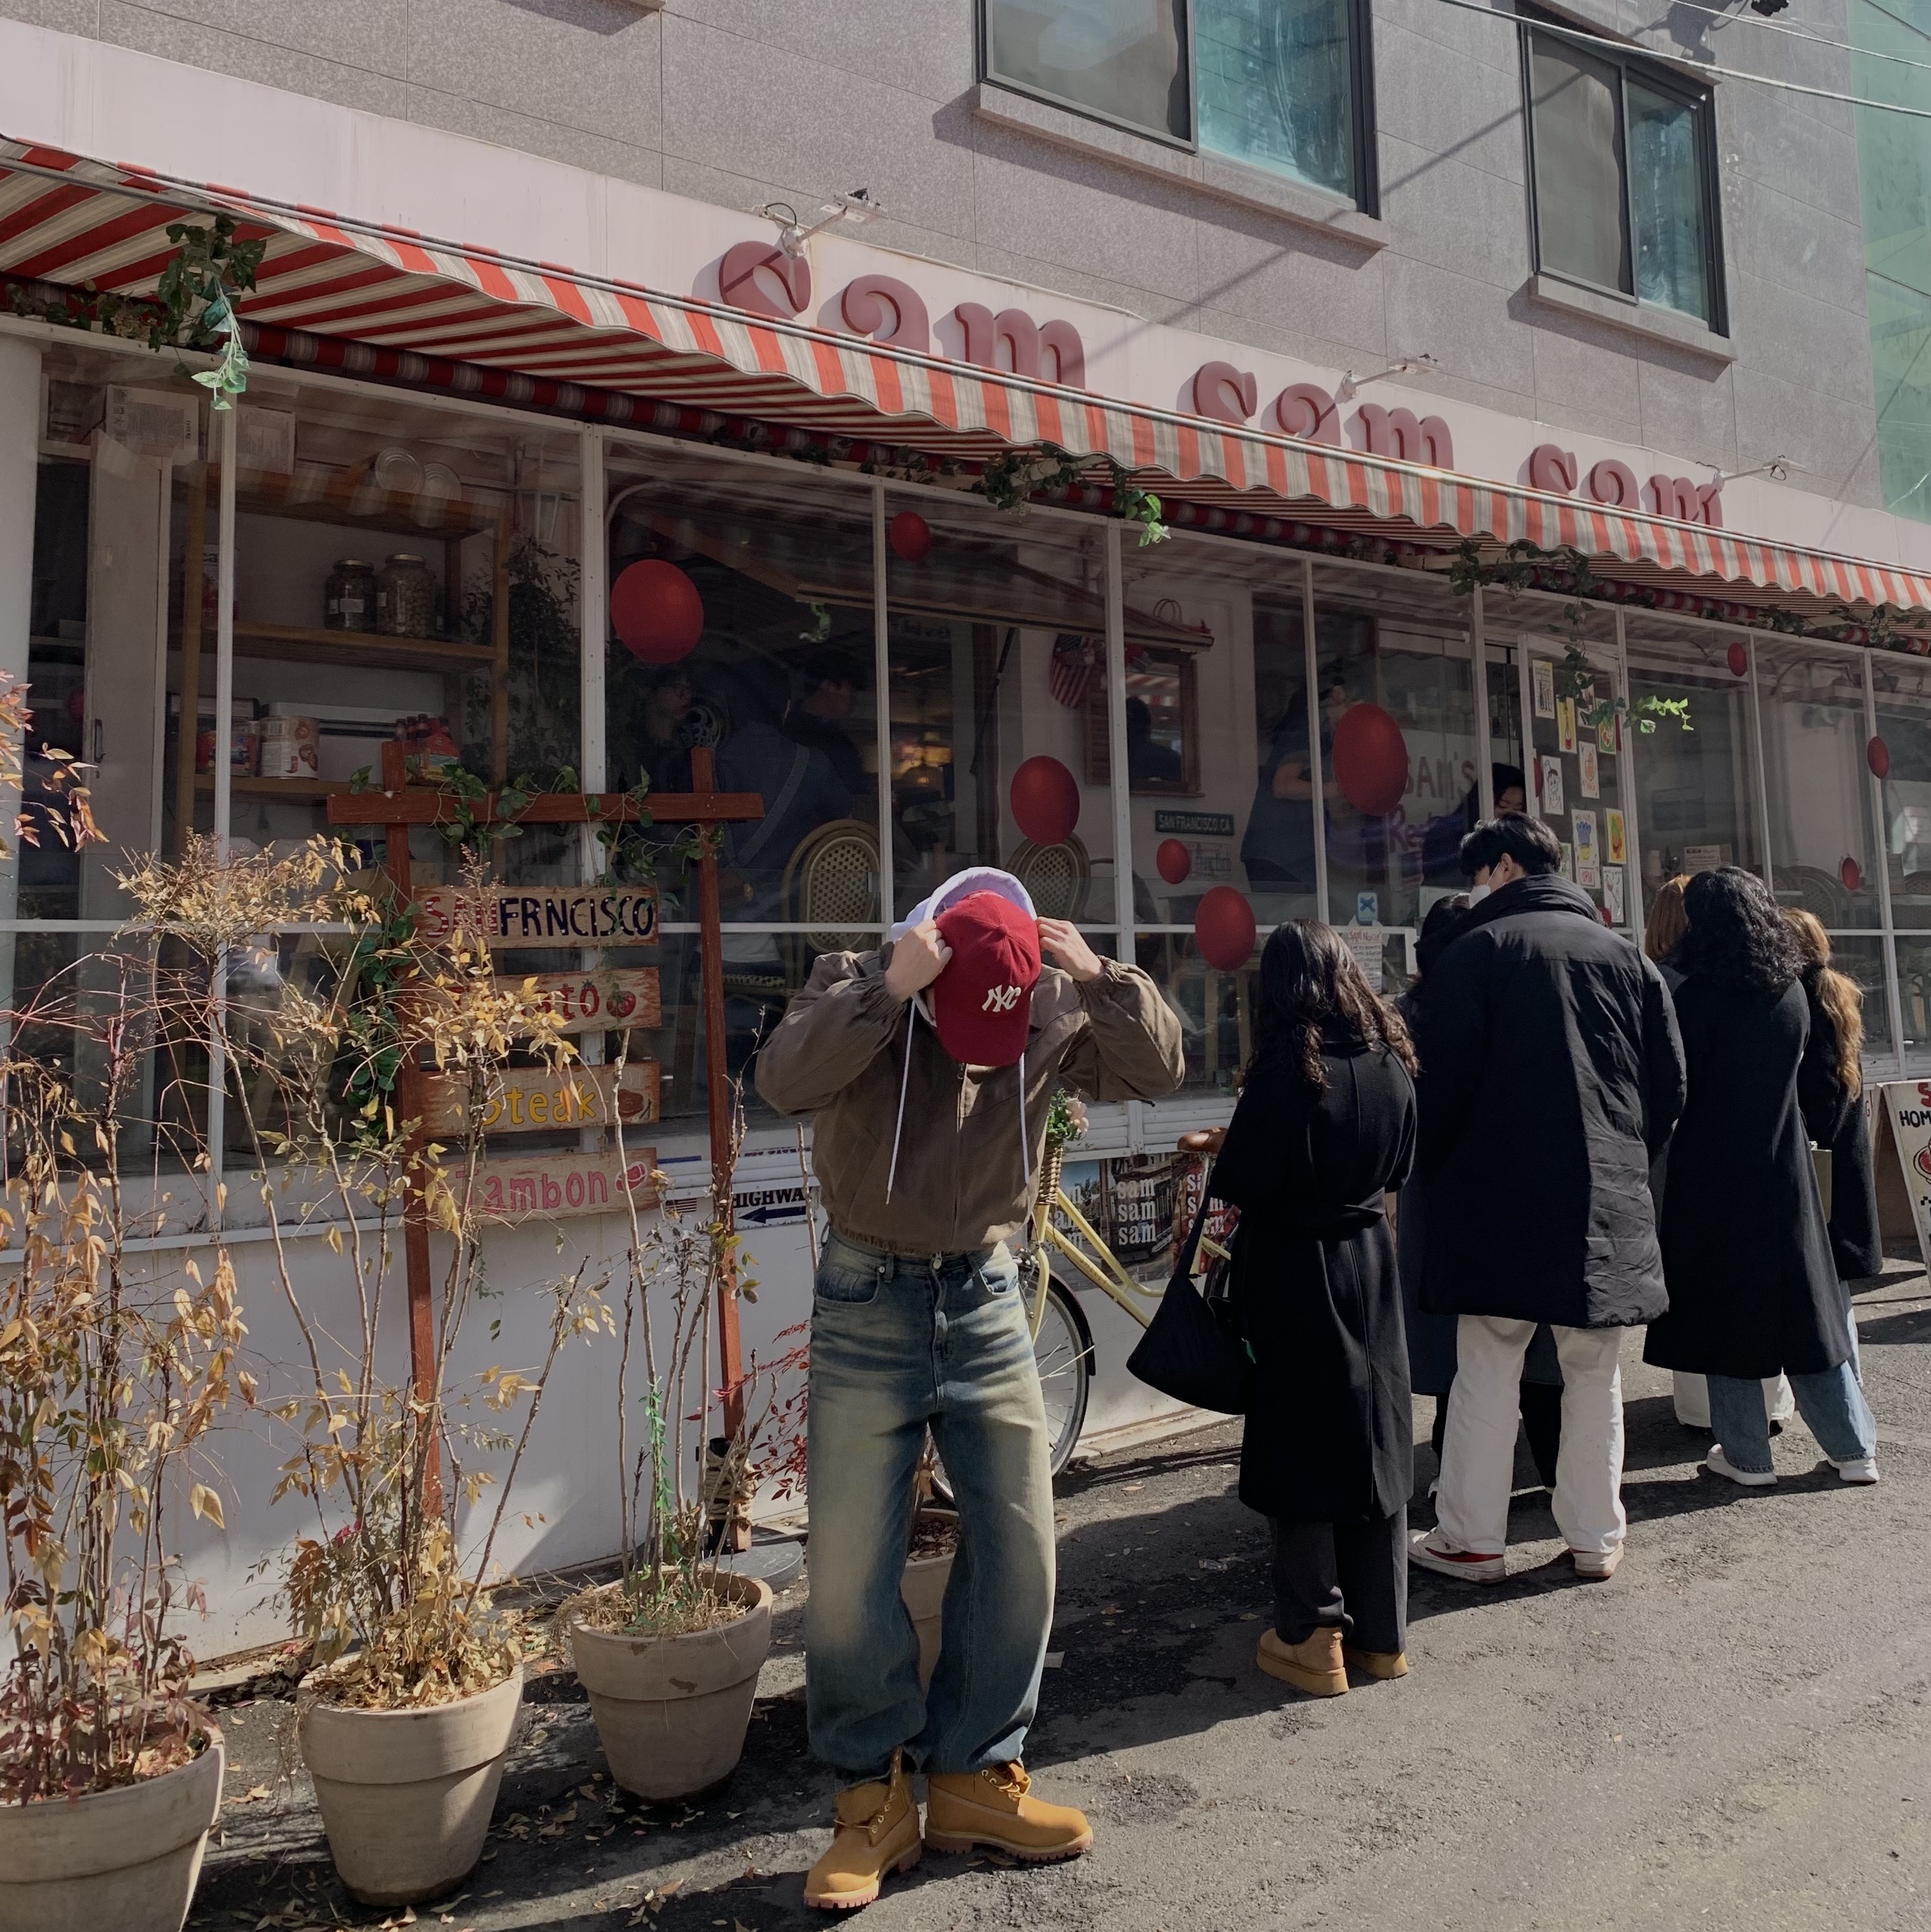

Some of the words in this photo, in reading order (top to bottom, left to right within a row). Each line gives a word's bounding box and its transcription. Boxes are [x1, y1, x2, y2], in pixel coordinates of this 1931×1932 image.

[1404, 751, 1475, 800] AM'S
[732, 1186, 813, 1208] HIGHWA
[1117, 1178, 1156, 1199] sam
[1118, 1201, 1156, 1222] sam
[1187, 1196, 1225, 1214] sm
[1118, 1222, 1157, 1245] sam
[1187, 1215, 1225, 1235] sm
